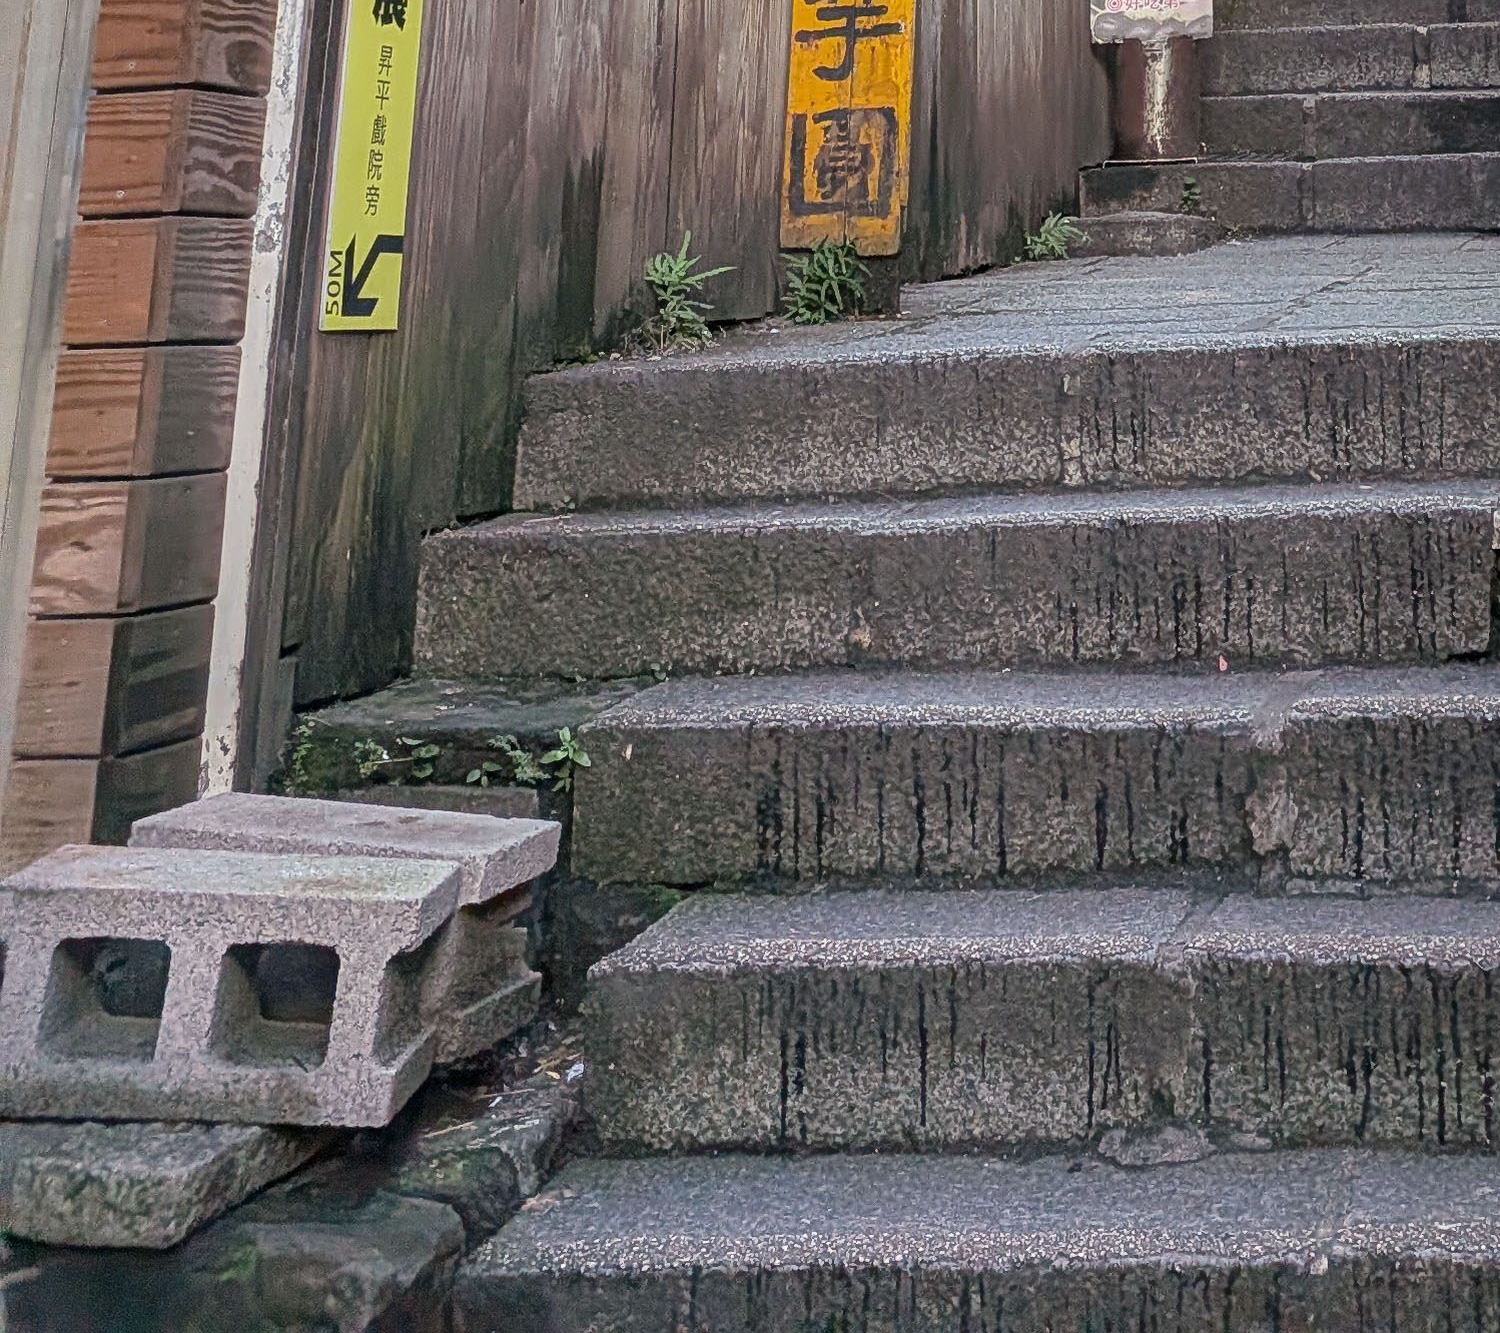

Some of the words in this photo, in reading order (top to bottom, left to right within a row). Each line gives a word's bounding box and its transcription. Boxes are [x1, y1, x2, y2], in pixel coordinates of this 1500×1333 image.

[364, 44, 394, 218] 昇平戲院旁
[324, 249, 345, 318] 50M
